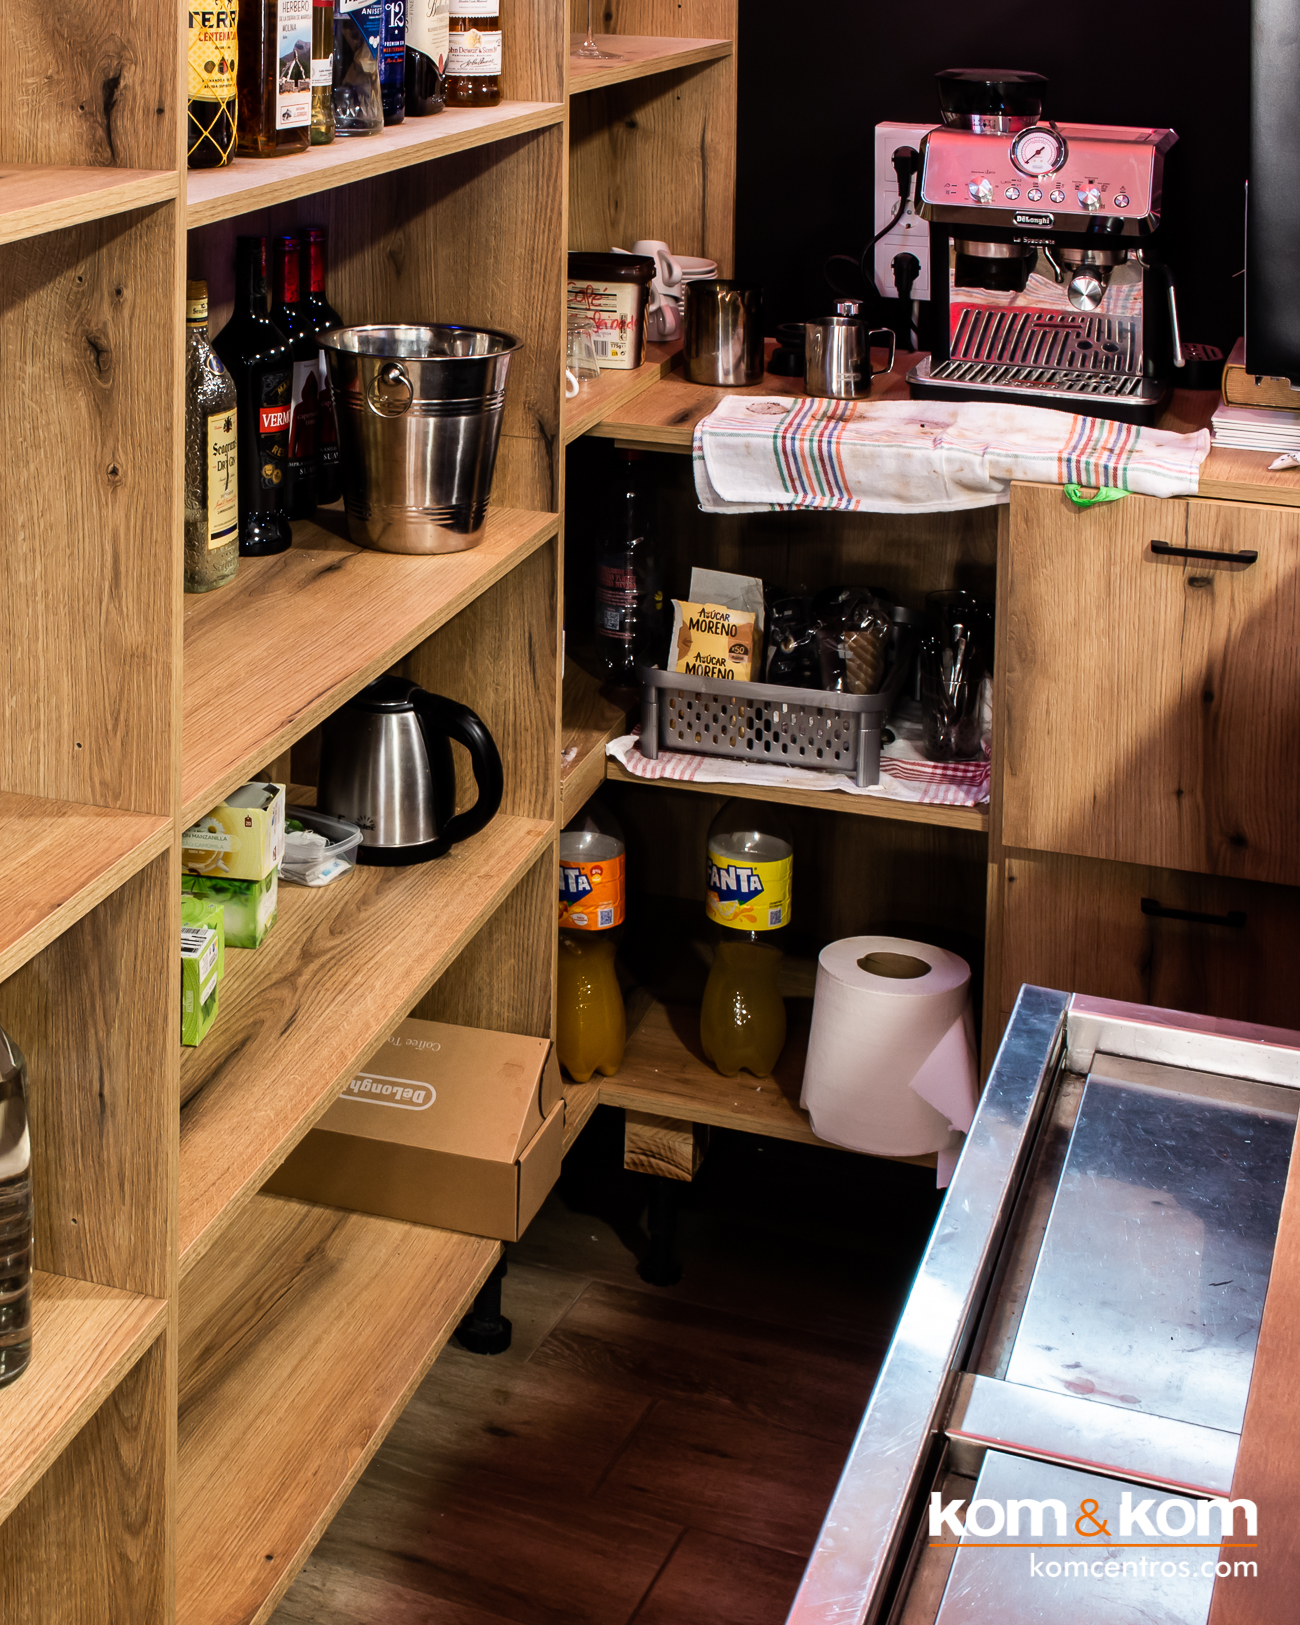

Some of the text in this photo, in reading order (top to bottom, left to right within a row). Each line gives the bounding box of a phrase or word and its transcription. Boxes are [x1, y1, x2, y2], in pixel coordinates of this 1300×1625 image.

[282, 0, 310, 14] HERBERO
[688, 616, 738, 638] MORENO
[192, 833, 228, 842] MANZANILLA
[405, 1038, 441, 1052] Coffee
